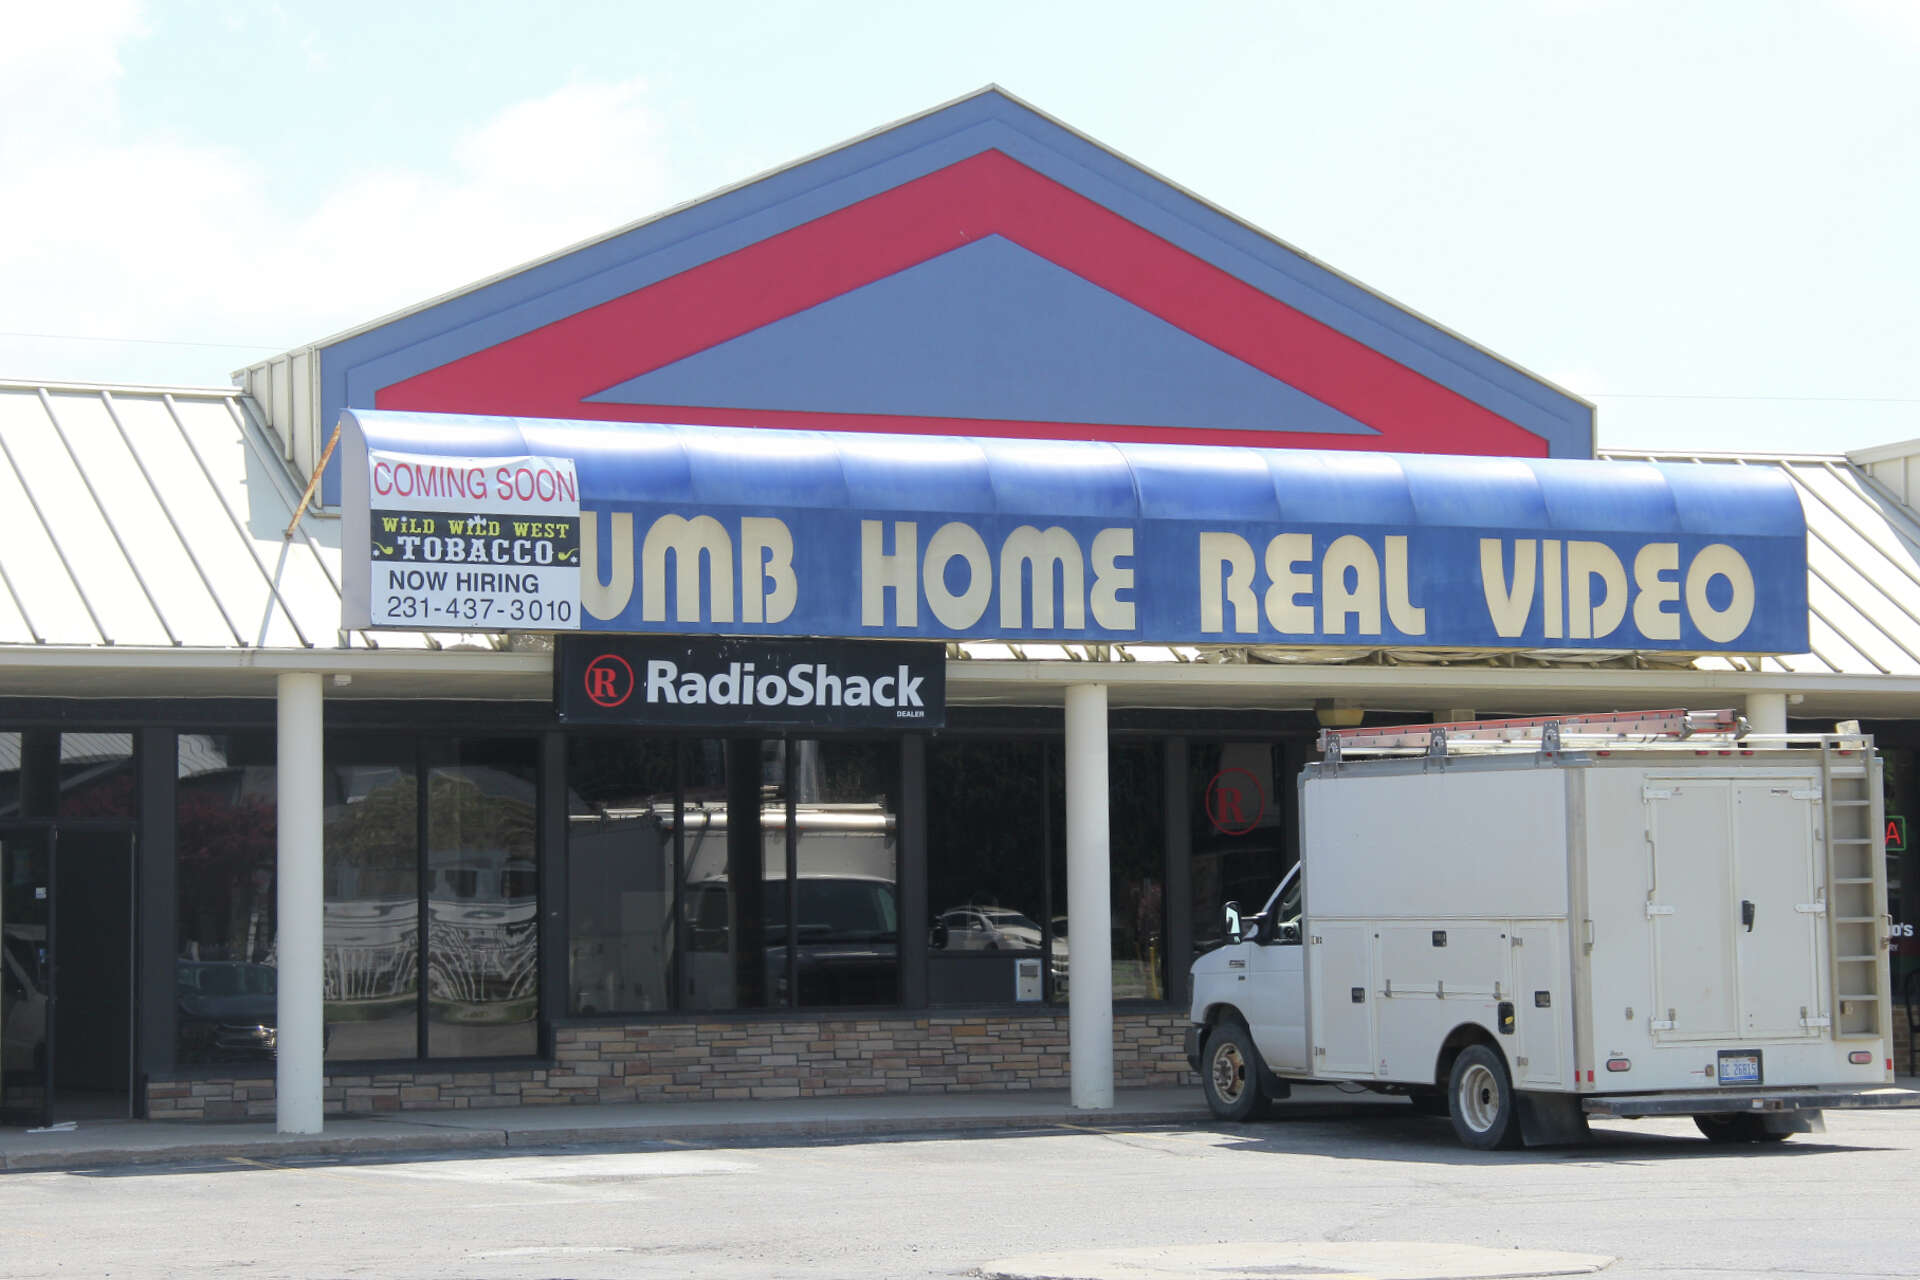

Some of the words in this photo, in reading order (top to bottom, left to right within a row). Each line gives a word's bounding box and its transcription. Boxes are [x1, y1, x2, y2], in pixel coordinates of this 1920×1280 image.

[374, 462, 488, 499] COMING
[496, 467, 576, 502] SOON
[513, 522, 570, 538] WEST
[397, 536, 554, 565] TOBACCO
[389, 570, 448, 592] NOW
[456, 572, 539, 594] HIRING
[861, 520, 1136, 631] HOME
[1200, 532, 1426, 635] REAL
[1480, 538, 1756, 643] VIDEO
[387, 597, 572, 622] 231-437-3010
[646, 660, 925, 707] RadioShack
[896, 710, 925, 718] DEALER
[1889, 922, 1914, 937] o's
